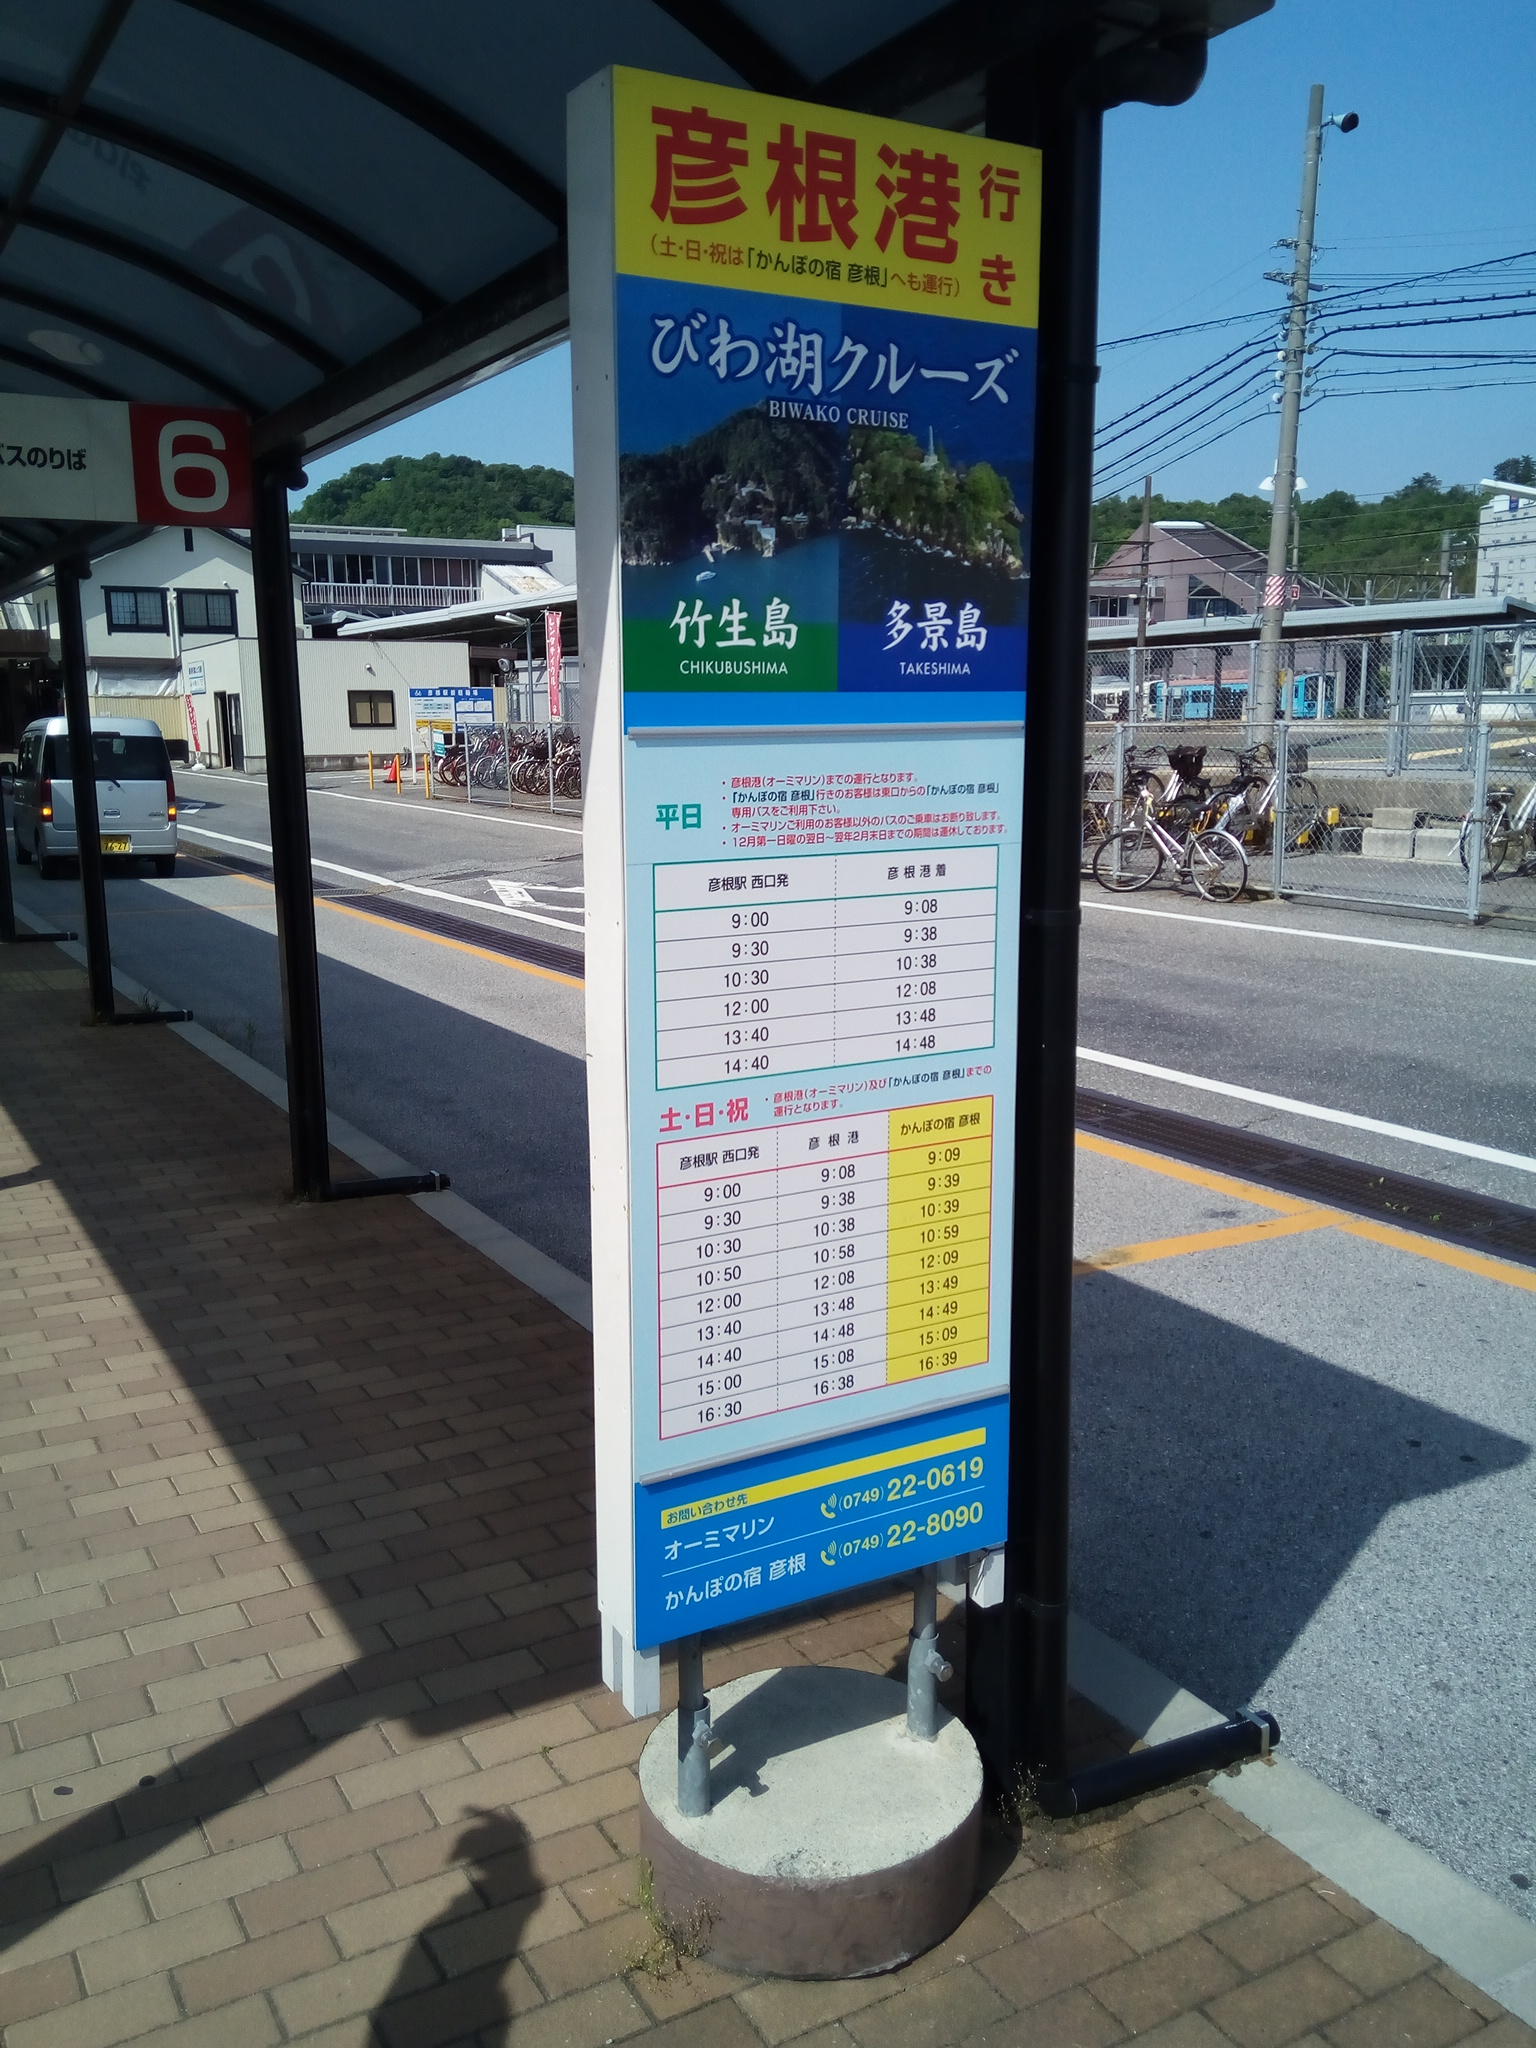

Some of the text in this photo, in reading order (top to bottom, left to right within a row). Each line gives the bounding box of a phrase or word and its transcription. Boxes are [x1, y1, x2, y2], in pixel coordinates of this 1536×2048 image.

[650, 105, 961, 265] 彦根港
[979, 163, 1021, 306] 行き
[650, 312, 1019, 404] びわ湖クルーズ
[769, 400, 909, 429] BIWAKO CRUISE
[0, 443, 87, 470] スのりば
[158, 419, 230, 513] 6
[669, 597, 799, 650] 竹生島
[882, 599, 988, 652] 多景島
[680, 660, 788, 675] CHIKUBUSHIMA
[899, 662, 971, 676] TAKESHIMA
[656, 803, 702, 830] 平日
[708, 874, 789, 892] 彦根駅 西口発
[904, 899, 938, 915] 9:08
[731, 911, 769, 928] 9:00
[904, 927, 937, 943] 9:38
[731, 941, 769, 958] 9:30
[896, 954, 937, 971] 10:38
[724, 970, 769, 987] 10:30
[896, 981, 936, 998] 12:08
[724, 999, 769, 1017] 12:00
[896, 1008, 936, 1025] 13:48
[724, 1027, 769, 1045] 13:40
[895, 1035, 936, 1052] 14:48
[724, 1056, 769, 1074] 14:40
[659, 1098, 748, 1133] 土・日・祝
[900, 1113, 980, 1136] かんぽの宿 彦根
[679, 1146, 760, 1171] 彦根駅 西口発
[928, 1147, 960, 1165] 9:09
[821, 1165, 855, 1182] 9:08
[928, 1173, 960, 1191] 9:39
[704, 1183, 741, 1202] 9:00
[821, 1191, 855, 1209] 9:38
[920, 1199, 960, 1218] 10:39
[704, 1210, 741, 1230] 9:30
[813, 1218, 855, 1237] 10:38
[920, 1225, 960, 1243] 10:59
[696, 1238, 741, 1259] 10:30
[813, 1245, 855, 1264] 10:58
[920, 1250, 959, 1269] 12:09
[696, 1265, 741, 1287] 10:50
[813, 1271, 855, 1290] 12:08
[920, 1275, 959, 1295] 13:49
[697, 1293, 742, 1314] 12:00
[813, 1297, 855, 1317] 13:48
[919, 1301, 958, 1320] 14:49
[697, 1320, 742, 1342] 13:40
[813, 1323, 855, 1343] 14:48
[919, 1326, 958, 1346] 15:09
[697, 1347, 742, 1369] 14:40
[813, 1349, 854, 1370] 15:08
[918, 1351, 957, 1372] 16:39
[697, 1374, 742, 1396] 15:00
[813, 1375, 854, 1396] 16:38
[697, 1401, 742, 1423] 16:30
[838, 1456, 984, 1512] (0749) 22-0619
[666, 1492, 748, 1525] お問い合わせ先
[663, 1516, 775, 1560] オーミマリン
[838, 1502, 984, 1558] (0749) 22-8090
[665, 1552, 806, 1611] かんぽの宿 彦根
